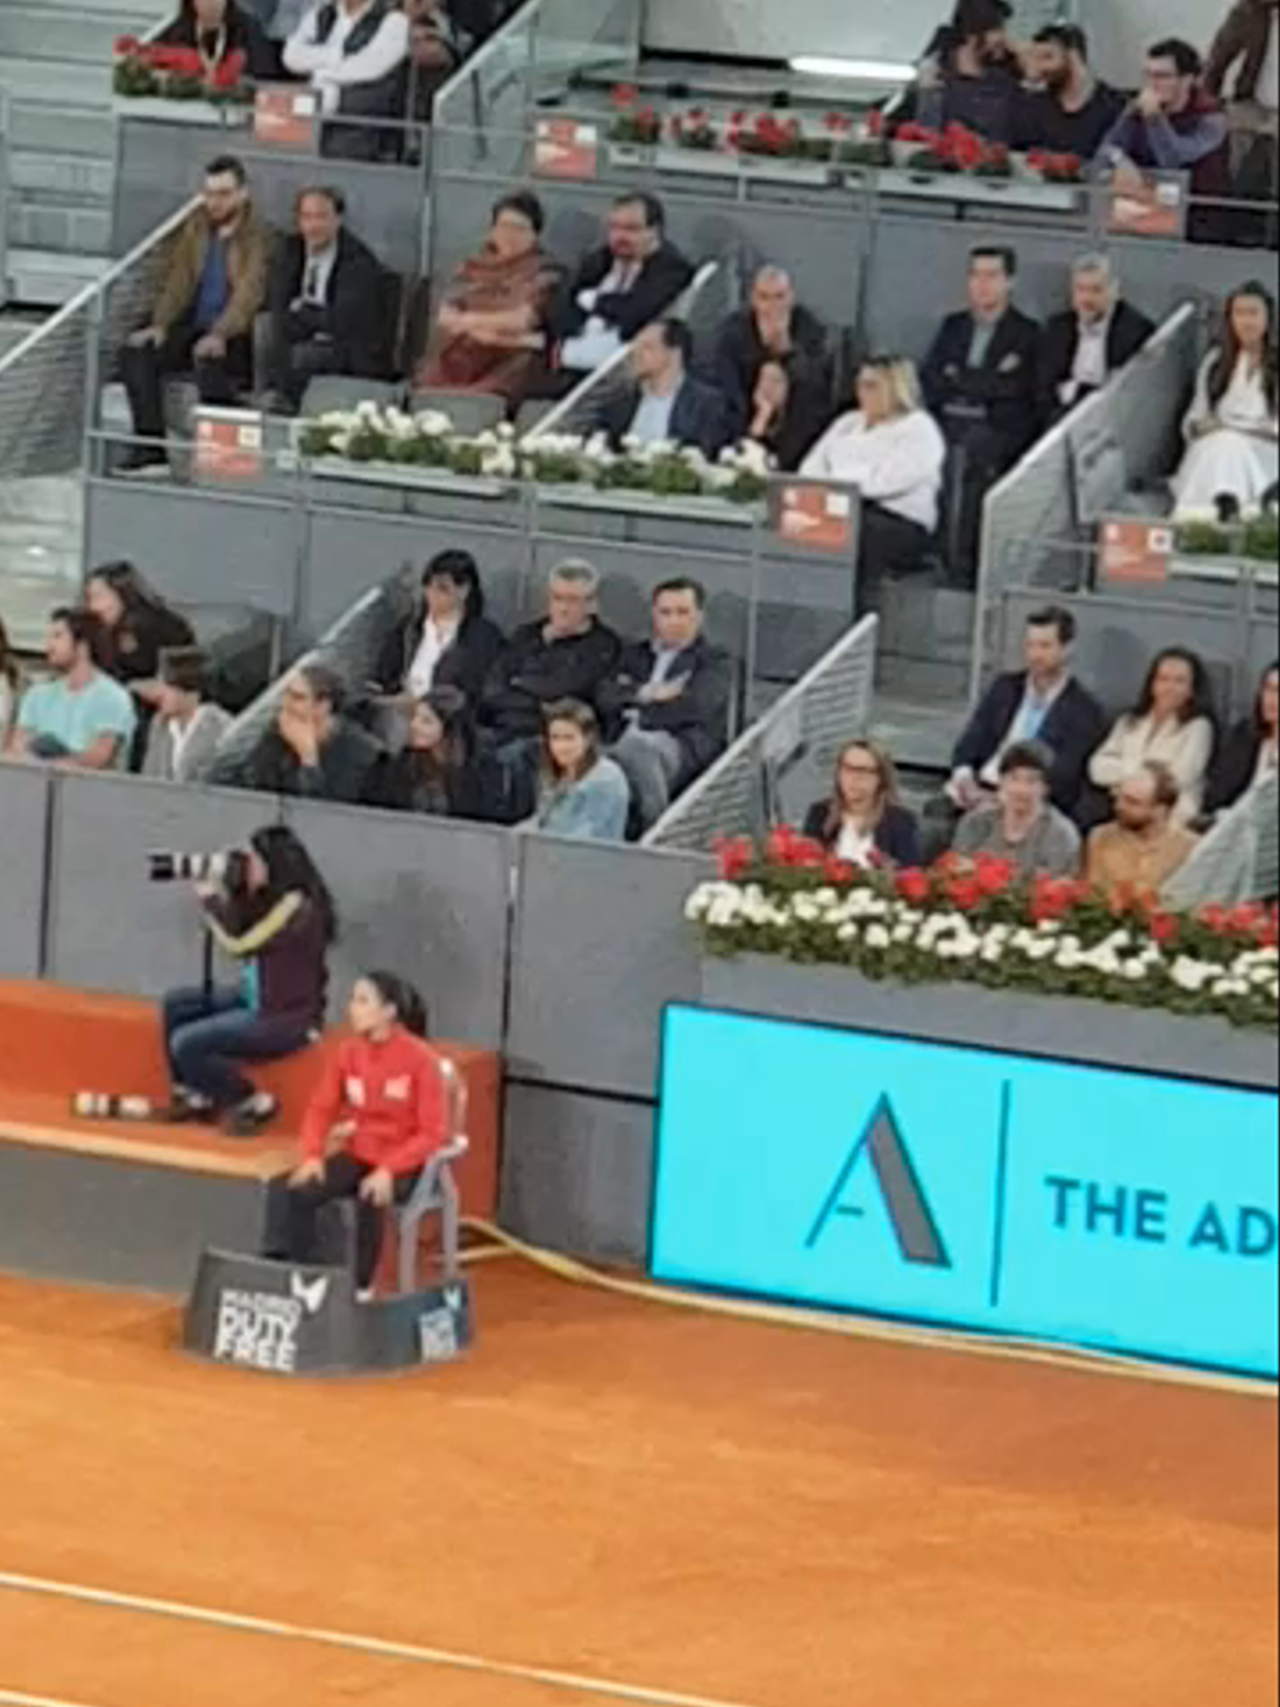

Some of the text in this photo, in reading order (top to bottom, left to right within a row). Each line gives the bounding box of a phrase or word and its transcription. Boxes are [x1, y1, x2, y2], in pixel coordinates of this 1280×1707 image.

[1043, 1175, 1168, 1244] THE
[217, 1306, 300, 1345] DUTY
[212, 1338, 297, 1373] FREE
